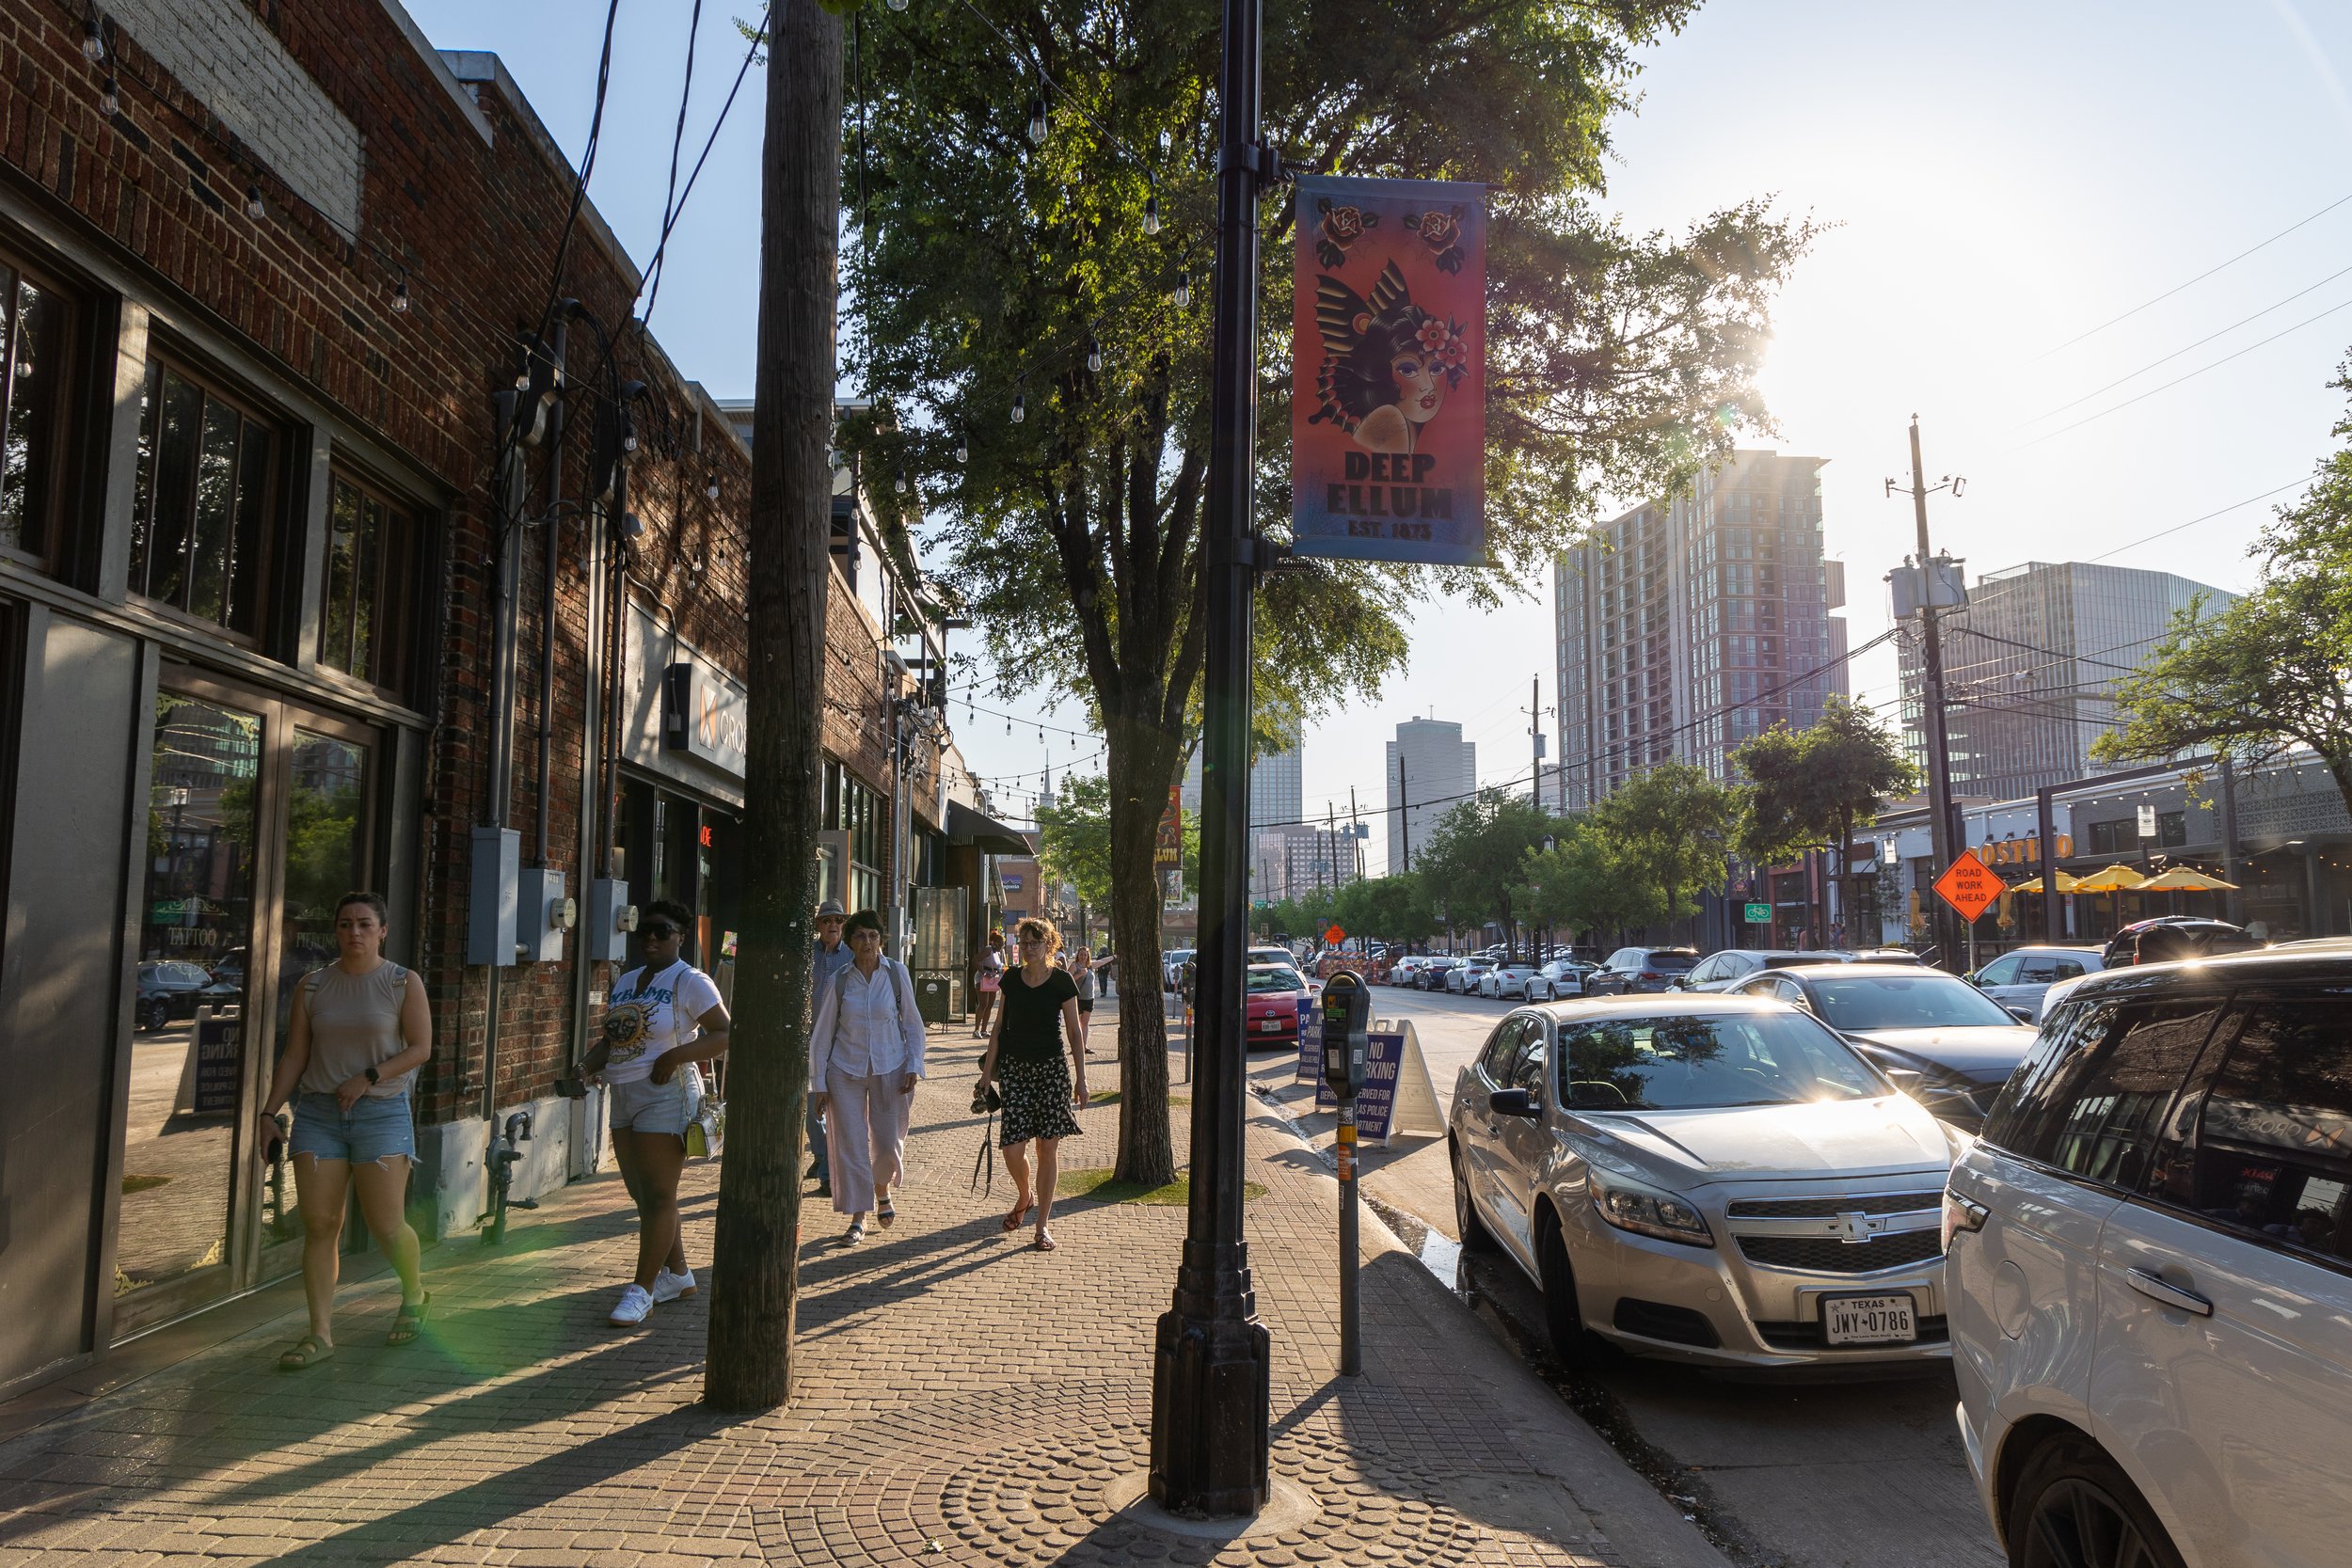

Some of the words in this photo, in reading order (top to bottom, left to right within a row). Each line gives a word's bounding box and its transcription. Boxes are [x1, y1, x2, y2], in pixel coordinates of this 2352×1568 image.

[1344, 451, 1437, 483] DEEP
[1327, 483, 1453, 519] ELLUM
[1348, 519, 1386, 539] EST.
[1391, 522, 1433, 541] 1873
[1156, 847, 1178, 862] LUM
[1967, 833, 2074, 866] OSTIO
[1956, 868, 1982, 878] ROAD
[1957, 880, 1983, 890] WORK
[1955, 894, 1987, 902] AHEAD
[168, 927, 217, 946] TATTOO
[1369, 1041, 1384, 1060] NO
[1366, 1061, 1396, 1081] RKING
[1358, 1087, 1378, 1100] ERVED
[1378, 1089, 1391, 1101] FOR
[1356, 1103, 1367, 1116] LAS
[1367, 1104, 1389, 1117] POLICE
[1851, 1299, 1885, 1309] TEXAS
[1833, 1312, 1859, 1334] JWY
[1868, 1310, 1909, 1332] 0786
